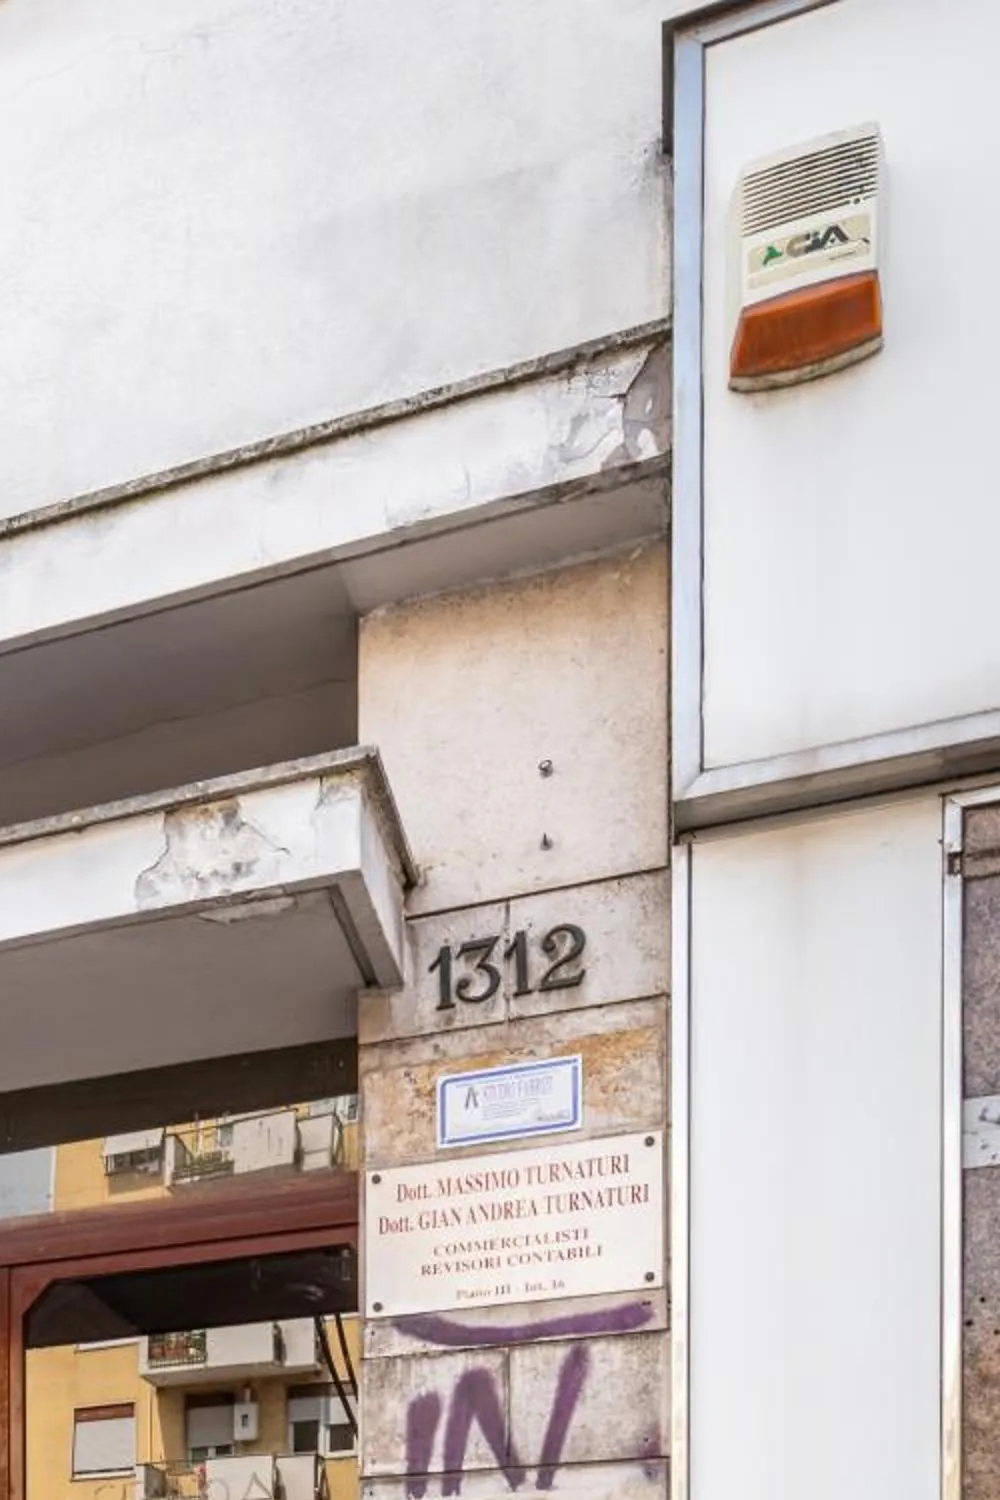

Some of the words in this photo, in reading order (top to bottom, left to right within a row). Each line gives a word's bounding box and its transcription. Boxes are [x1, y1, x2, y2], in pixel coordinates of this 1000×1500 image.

[429, 921, 588, 1011] 1312
[396, 1182, 431, 1203] Dott.
[437, 1170, 520, 1198] MASSIMO
[526, 1153, 630, 1186] TURNATURI
[378, 1213, 414, 1236] Dott.
[418, 1207, 462, 1231] GIAN
[464, 1199, 538, 1227] ANDREA
[542, 1183, 649, 1216] TURNATURI
[421, 1255, 502, 1277] REVISORI
[506, 1245, 603, 1267] CONTABILI
[433, 1227, 590, 1258] COMMERCIALISTI
